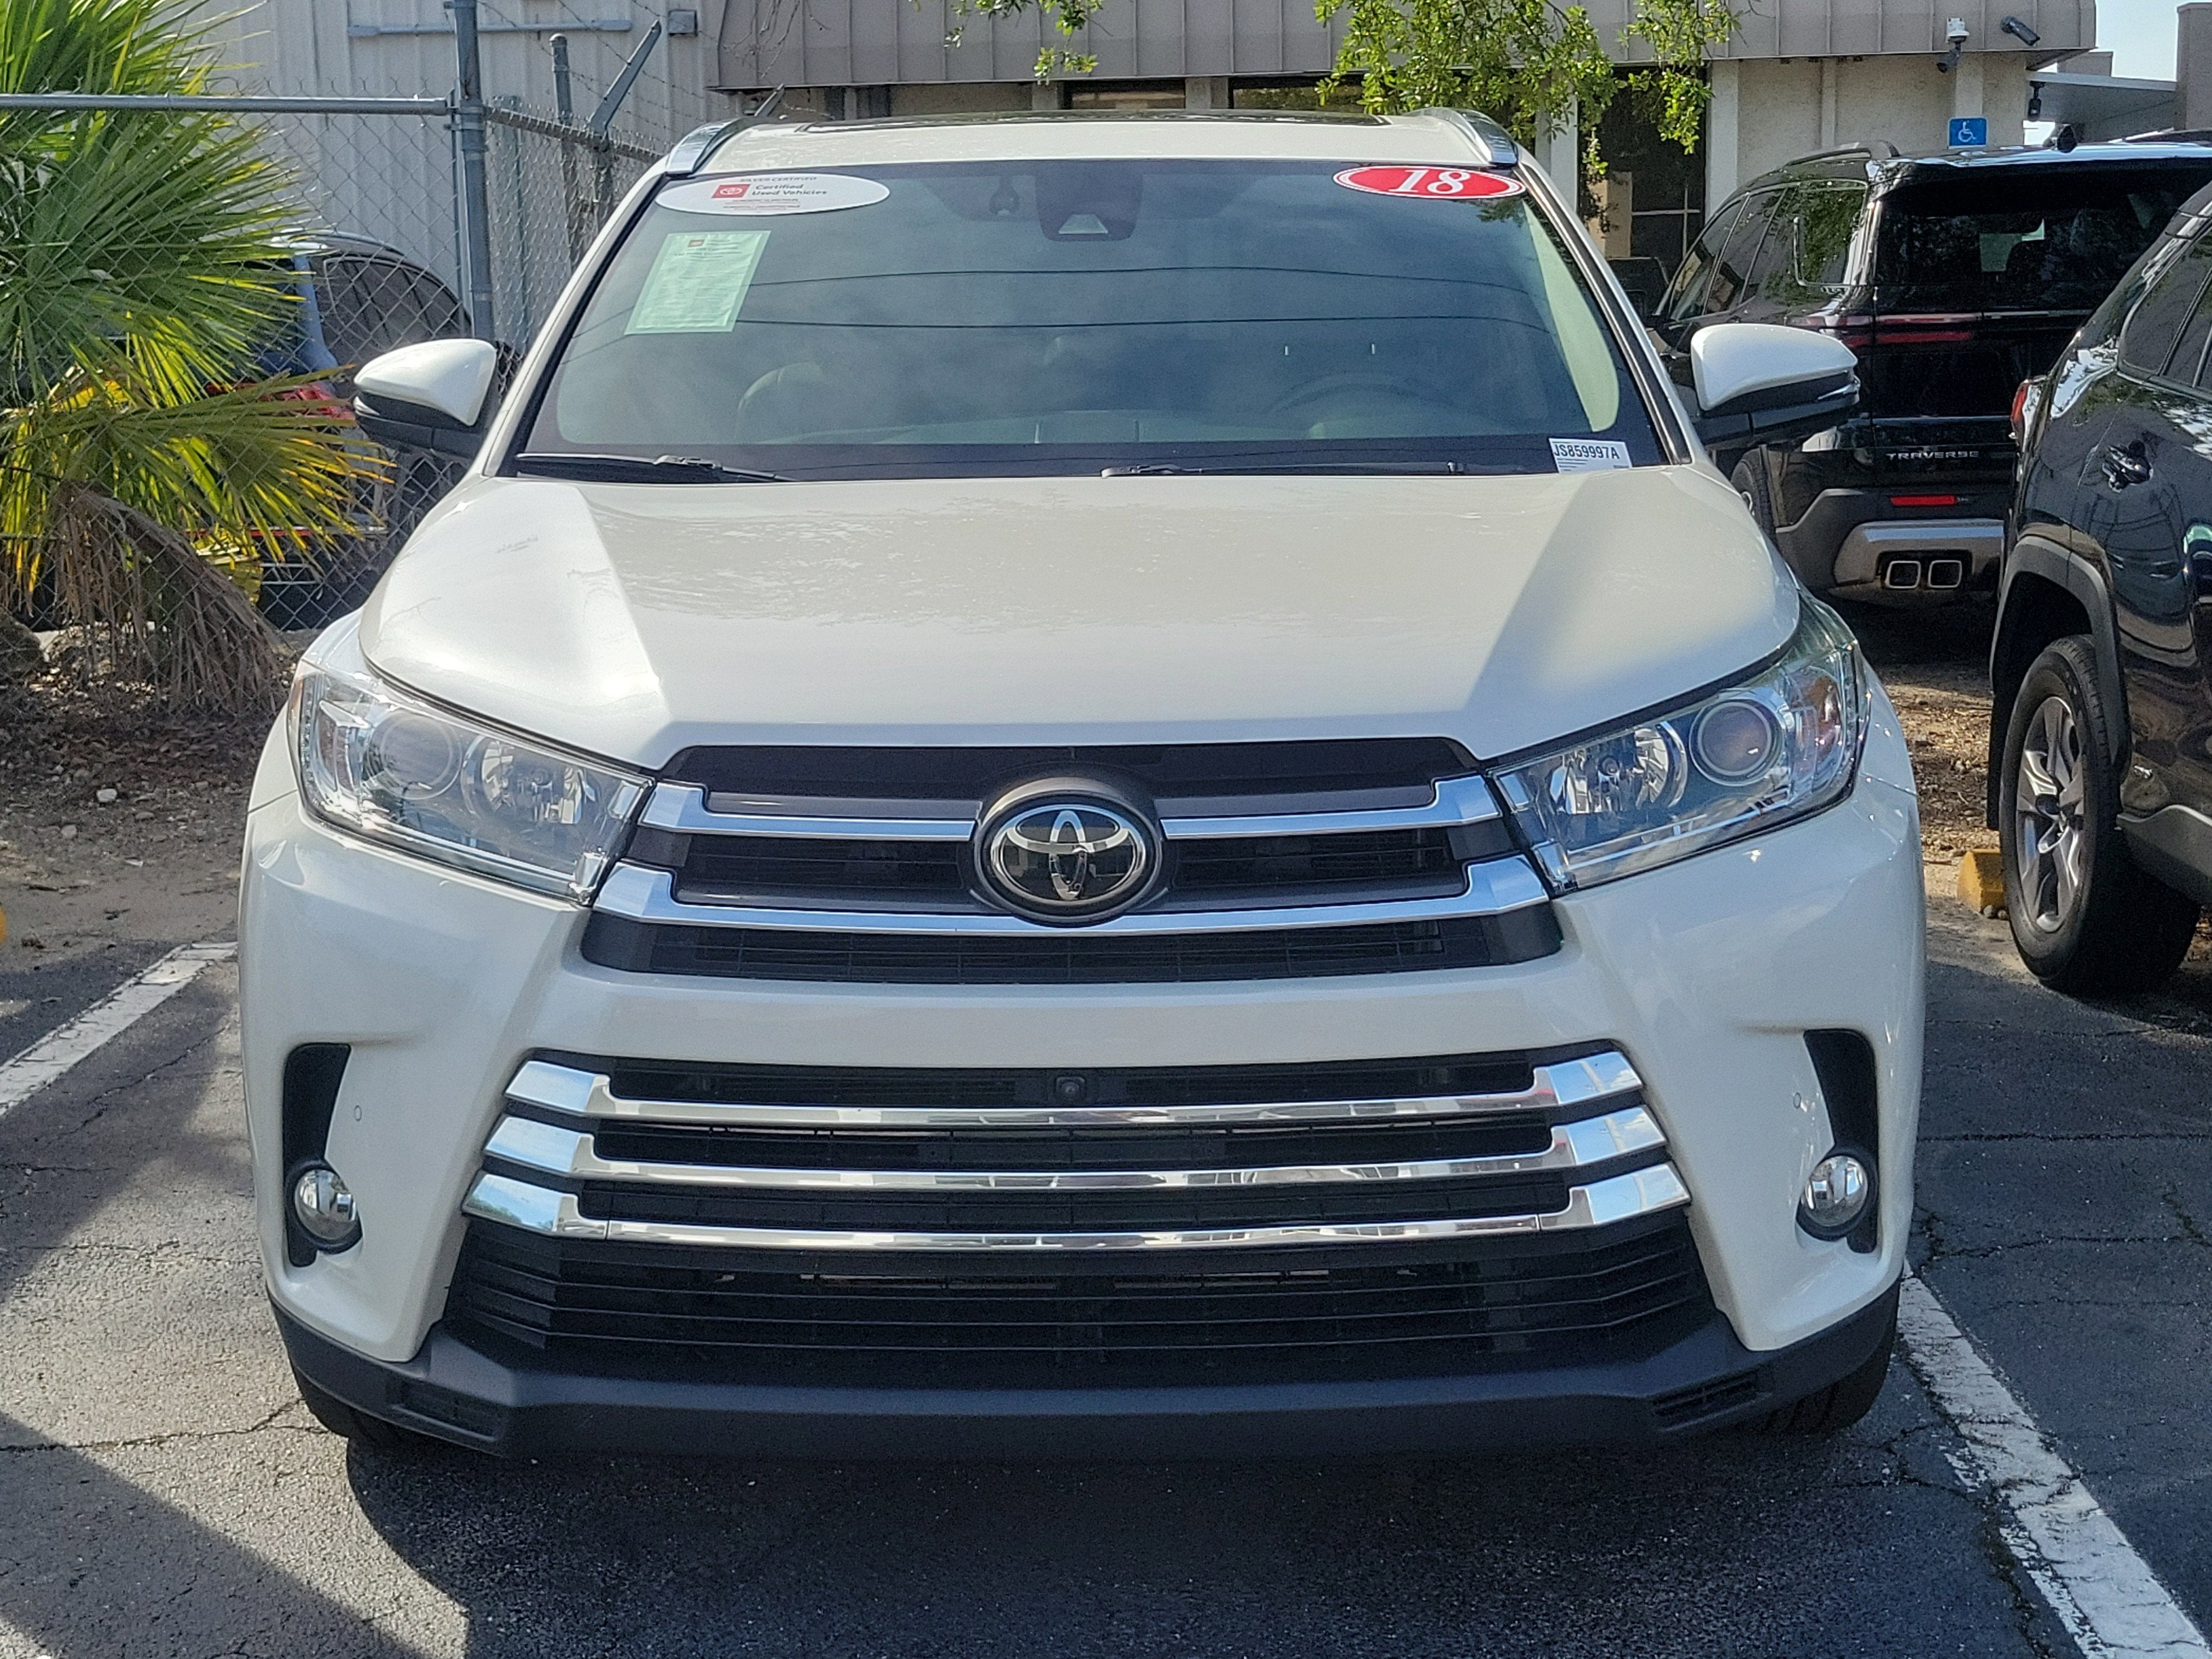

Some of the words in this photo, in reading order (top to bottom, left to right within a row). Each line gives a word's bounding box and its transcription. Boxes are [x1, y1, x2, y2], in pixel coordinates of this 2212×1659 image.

[1388, 169, 1470, 195] 18
[1554, 443, 1620, 460] JS859997A
[1886, 451, 1979, 460] TRAVERSE
